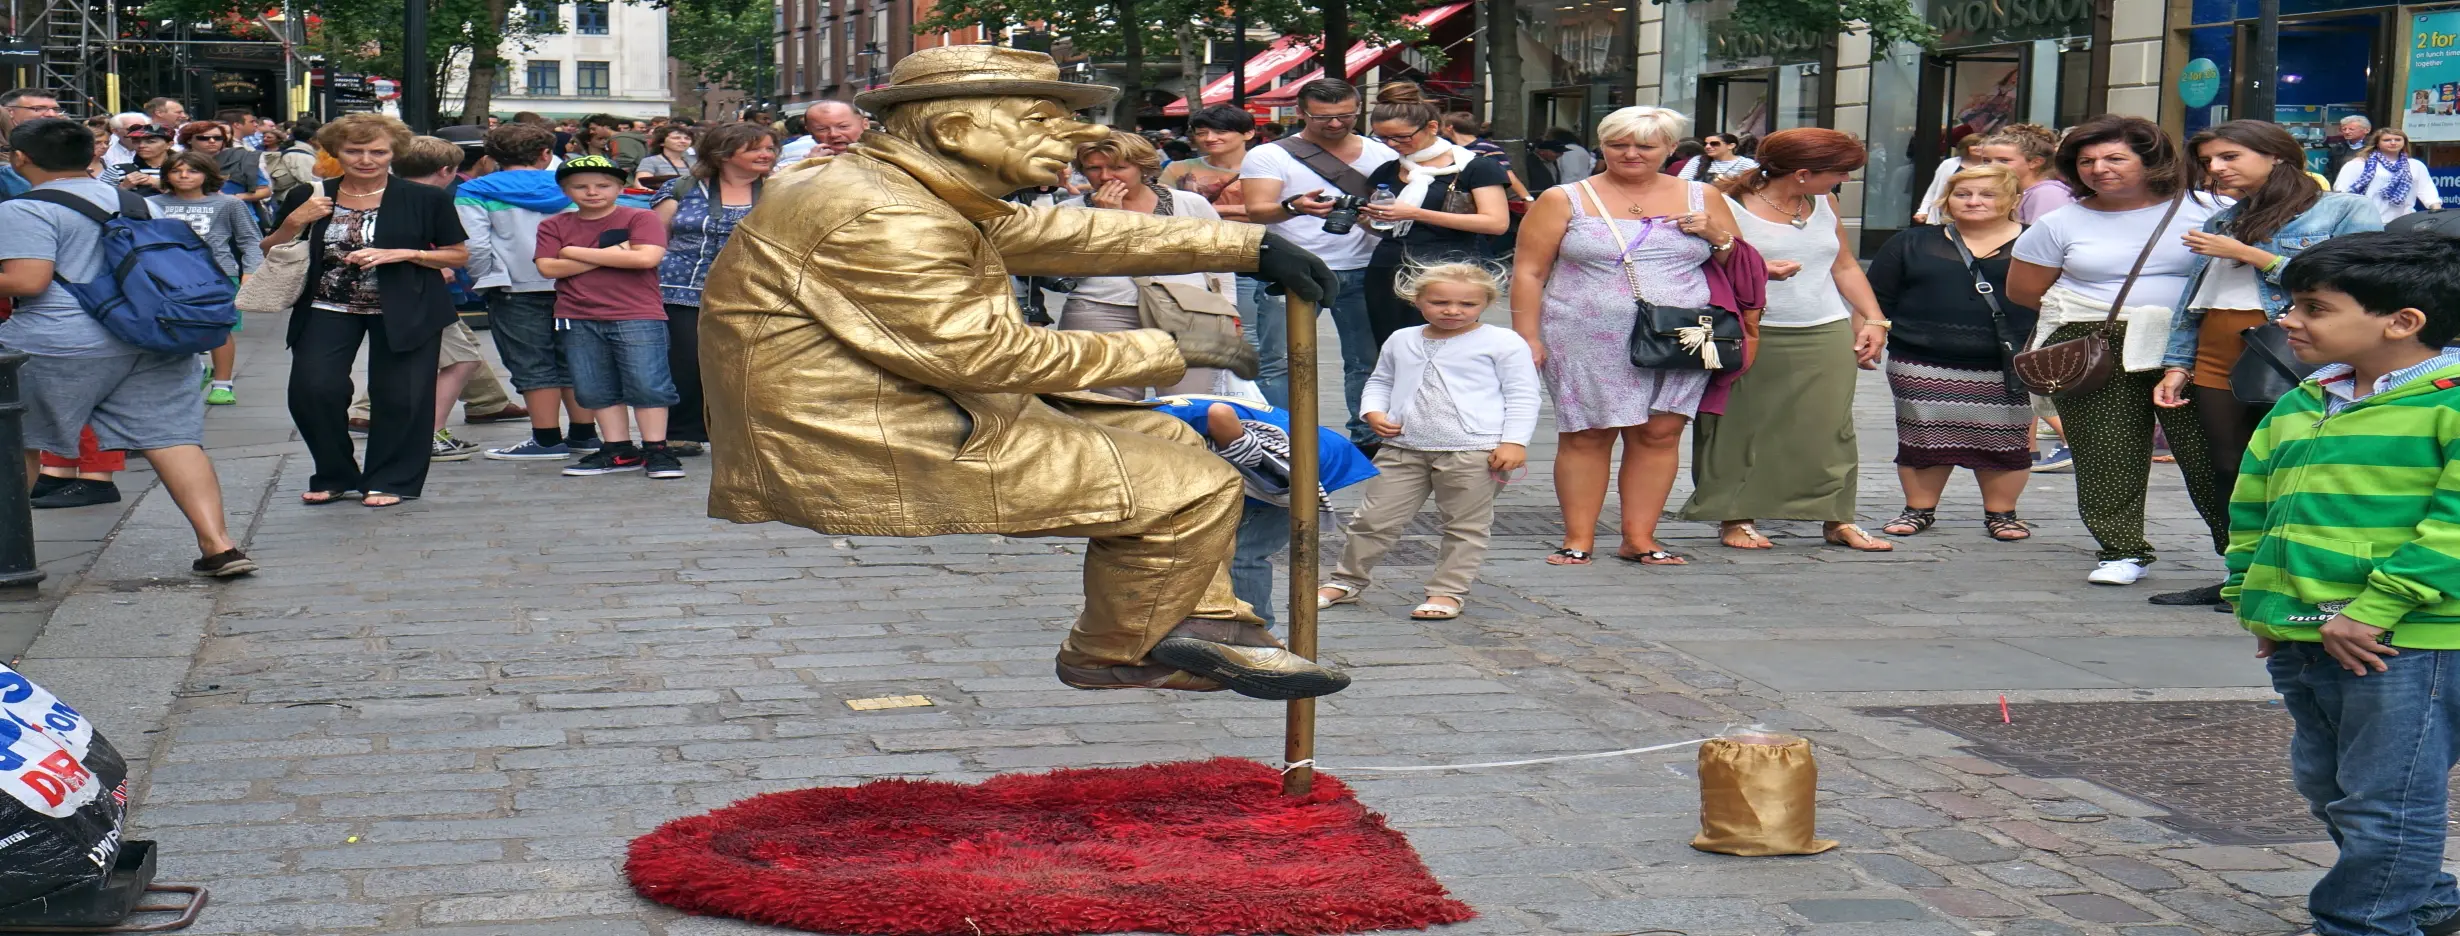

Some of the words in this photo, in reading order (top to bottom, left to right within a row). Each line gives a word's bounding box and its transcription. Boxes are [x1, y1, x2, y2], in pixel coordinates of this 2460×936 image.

[2417, 32, 2427, 49] 2
[2431, 31, 2457, 48] for
[2426, 50, 2444, 58] lunch
[2253, 81, 2260, 89] 2
[2440, 194, 2460, 205] auty
